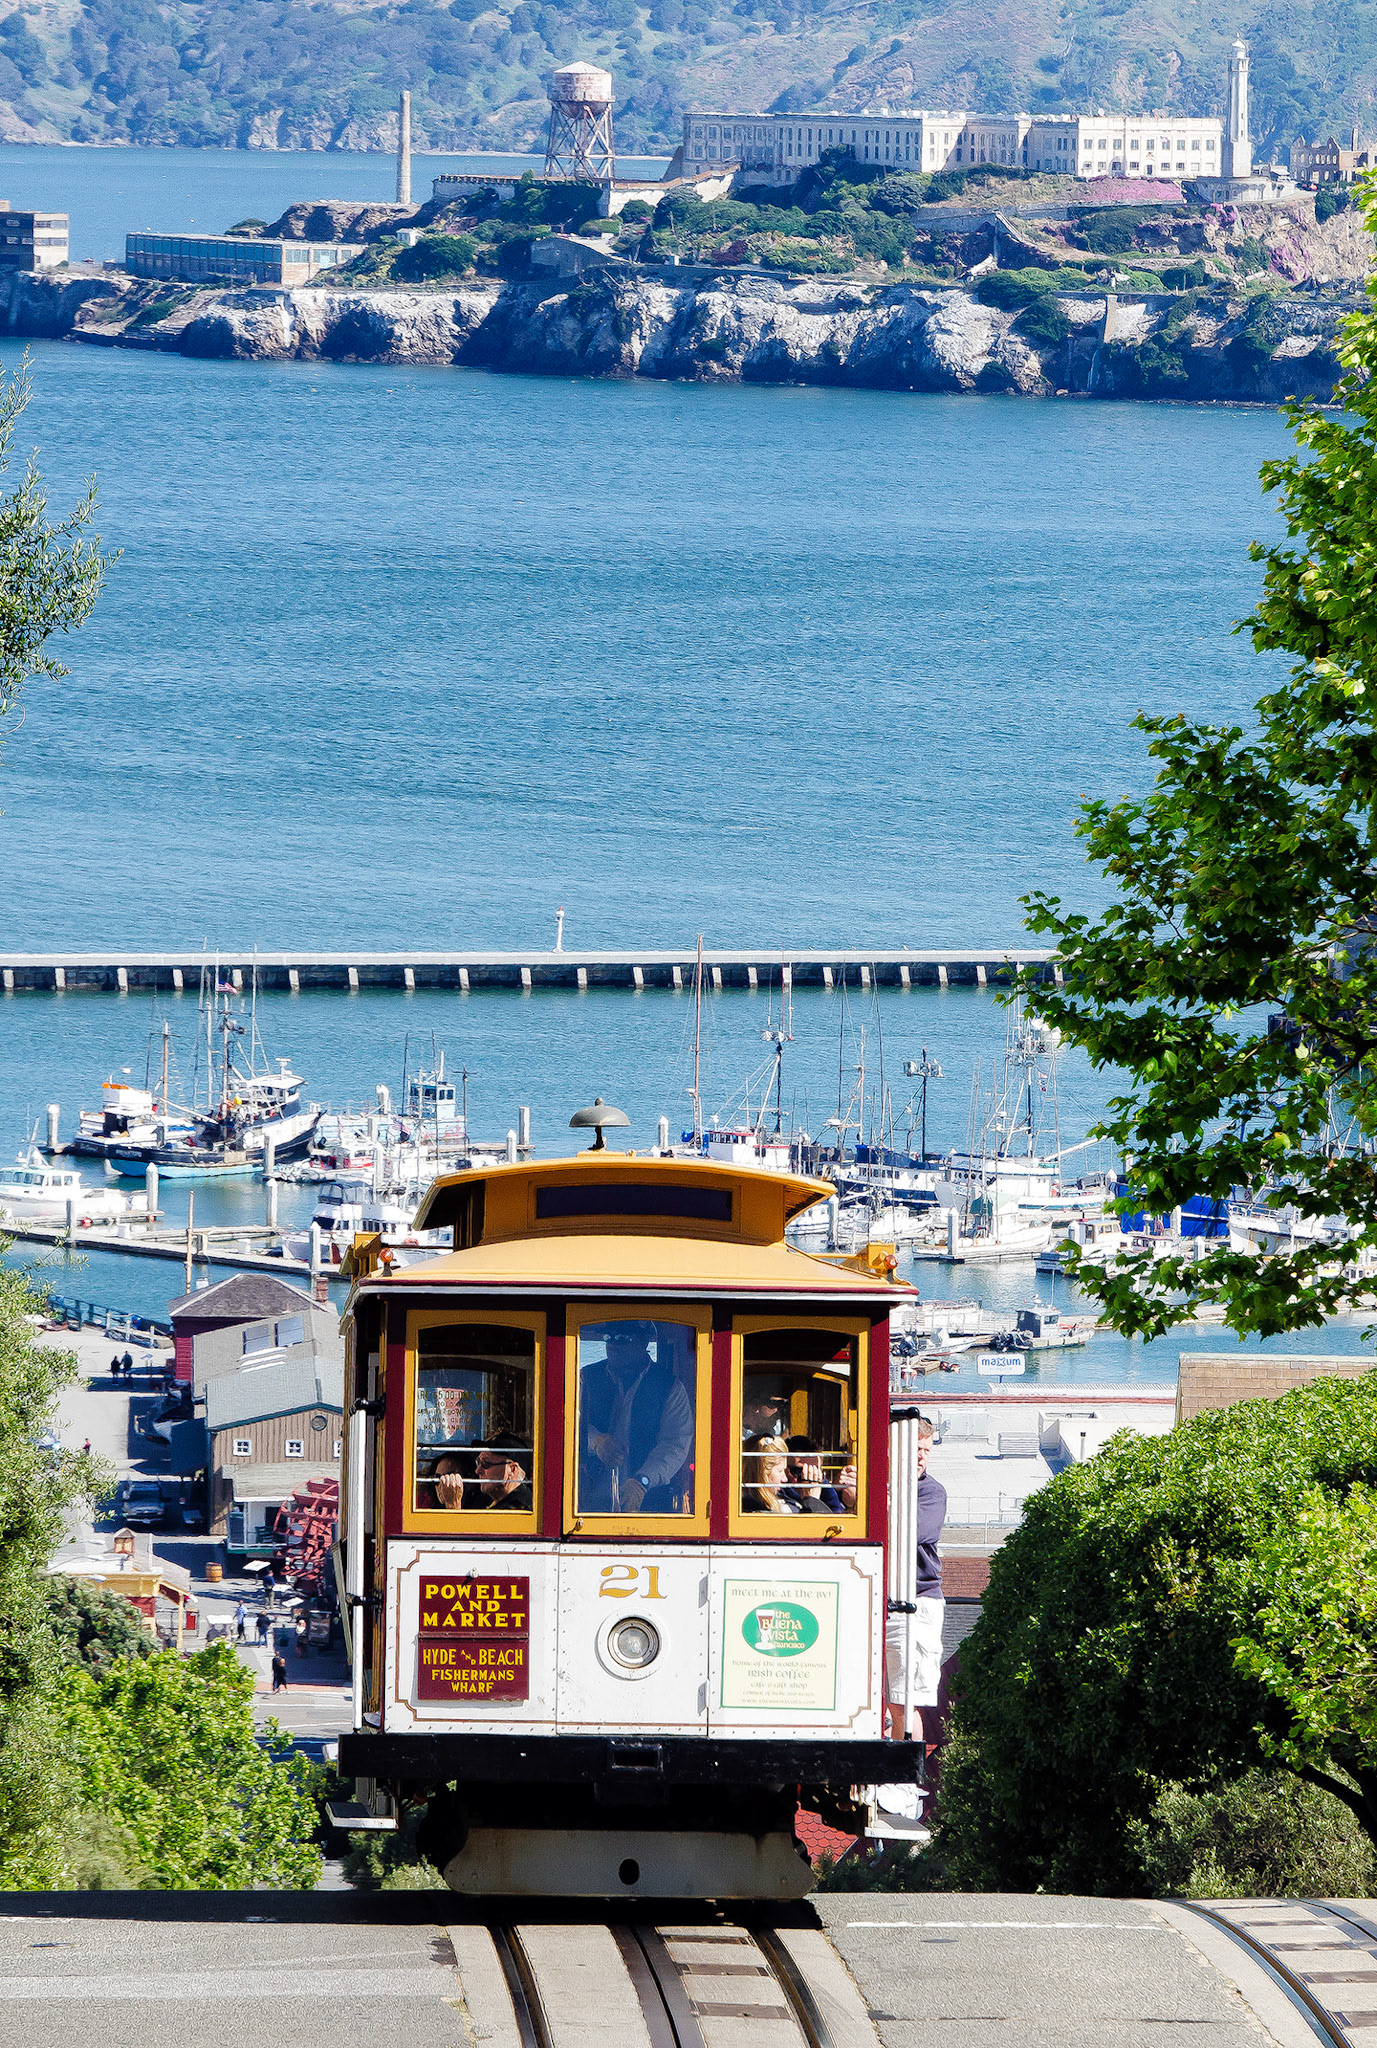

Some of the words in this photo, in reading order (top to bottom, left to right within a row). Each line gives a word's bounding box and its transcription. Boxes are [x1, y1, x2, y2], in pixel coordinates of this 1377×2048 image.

[982, 1357, 1020, 1366] maxum
[599, 1564, 668, 1598] 21
[426, 1584, 524, 1600] POWELL
[731, 1588, 759, 1597] meet
[762, 1589, 778, 1597] me
[795, 1589, 813, 1598] the
[451, 1600, 500, 1612] AND
[423, 1612, 526, 1628] MARKET
[776, 1610, 790, 1619] the
[761, 1618, 802, 1630] Buena
[423, 1648, 456, 1666] HYDE
[460, 1650, 476, 1666] AND
[478, 1649, 523, 1666] BEACH
[432, 1669, 514, 1680] FISHERMANS
[776, 1669, 810, 1680] coffee
[451, 1682, 494, 1693] WHARF
